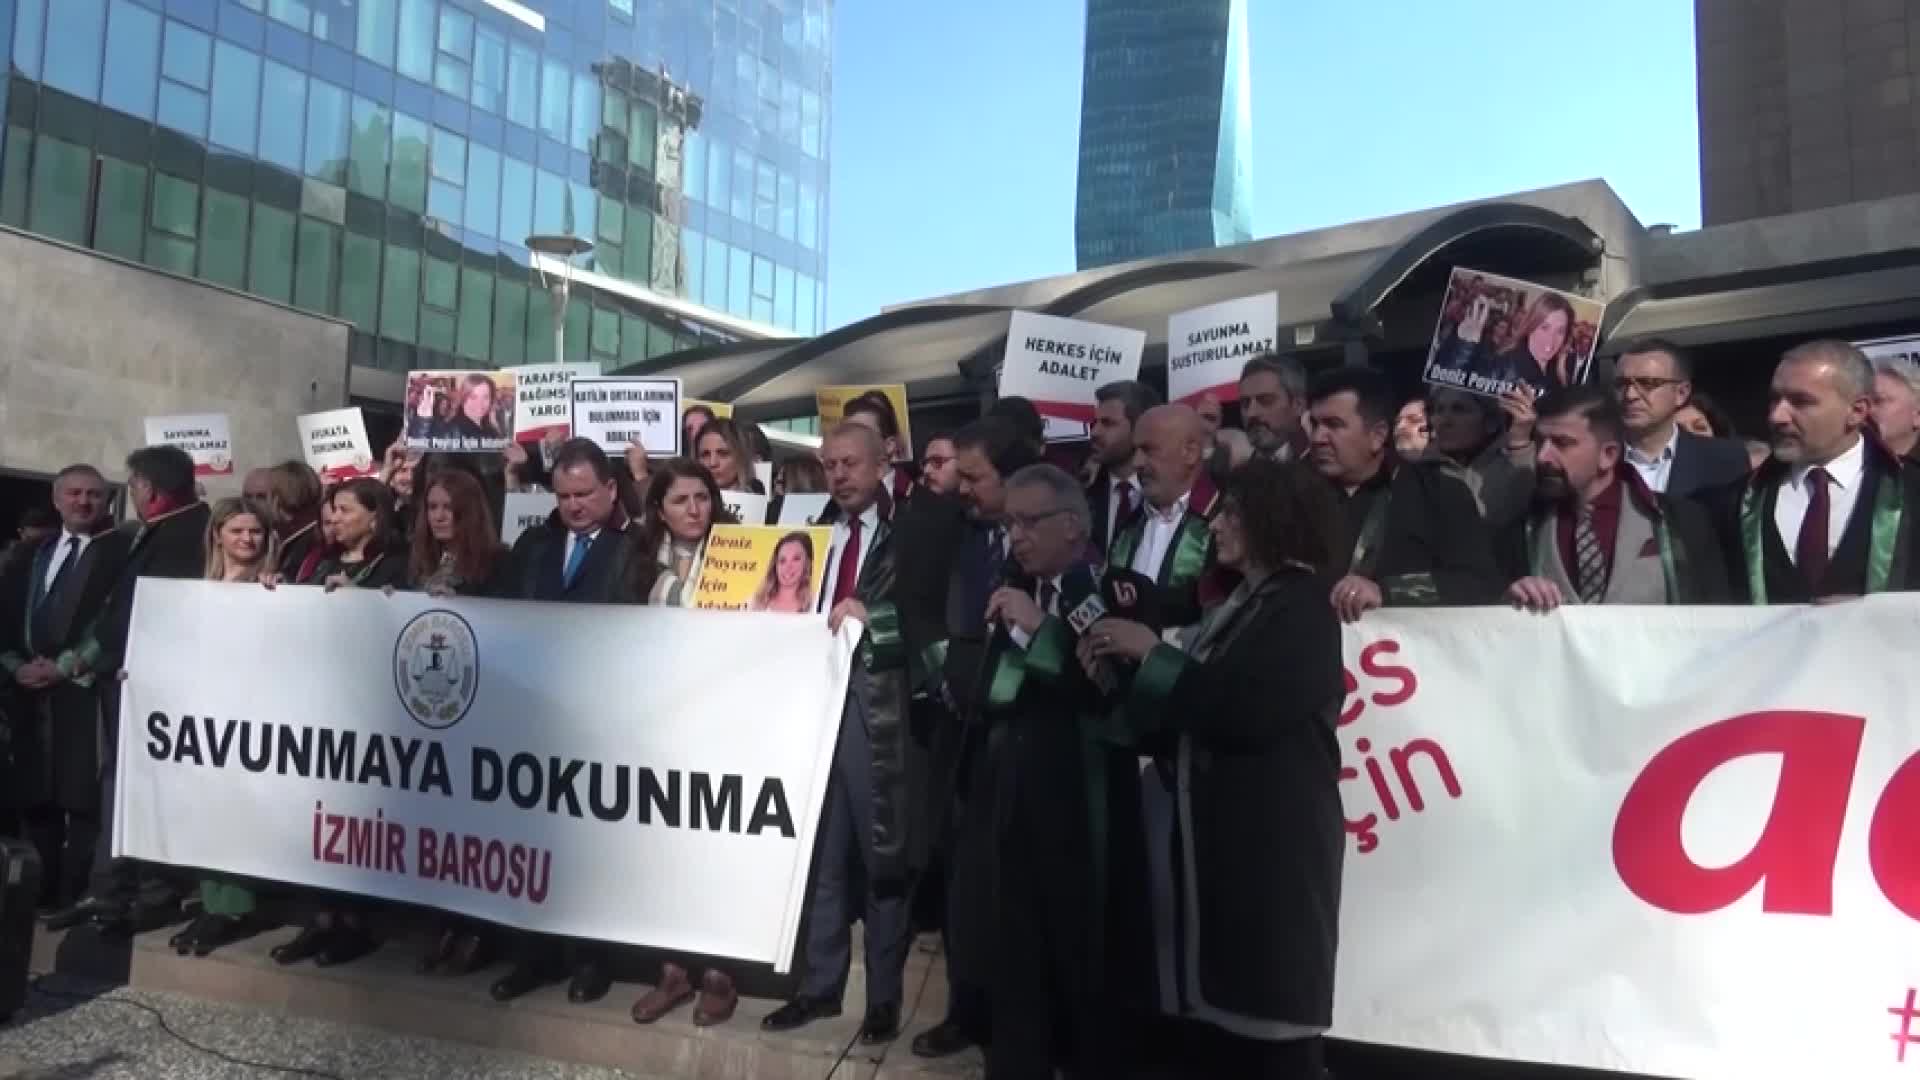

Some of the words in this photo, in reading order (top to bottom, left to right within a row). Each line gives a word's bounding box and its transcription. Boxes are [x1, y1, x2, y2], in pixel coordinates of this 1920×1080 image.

[1187, 322, 1250, 347] SAVUNMA
[1024, 336, 1086, 361] HERKES
[1090, 342, 1122, 366] İÇİN
[1171, 340, 1273, 370] SUSTURULAMAZ
[1038, 360, 1099, 381] ADALET
[519, 387, 570, 401] BAĞIMS
[529, 404, 567, 417] YARGI
[711, 535, 753, 550] Deniz
[704, 556, 757, 575] Poyraz
[699, 576, 728, 595] İçin
[147, 711, 453, 797] SAVUNMAYA
[471, 747, 796, 838] DOKUNMA
[312, 801, 406, 874] İZMİR
[417, 826, 551, 904] BAROSU
